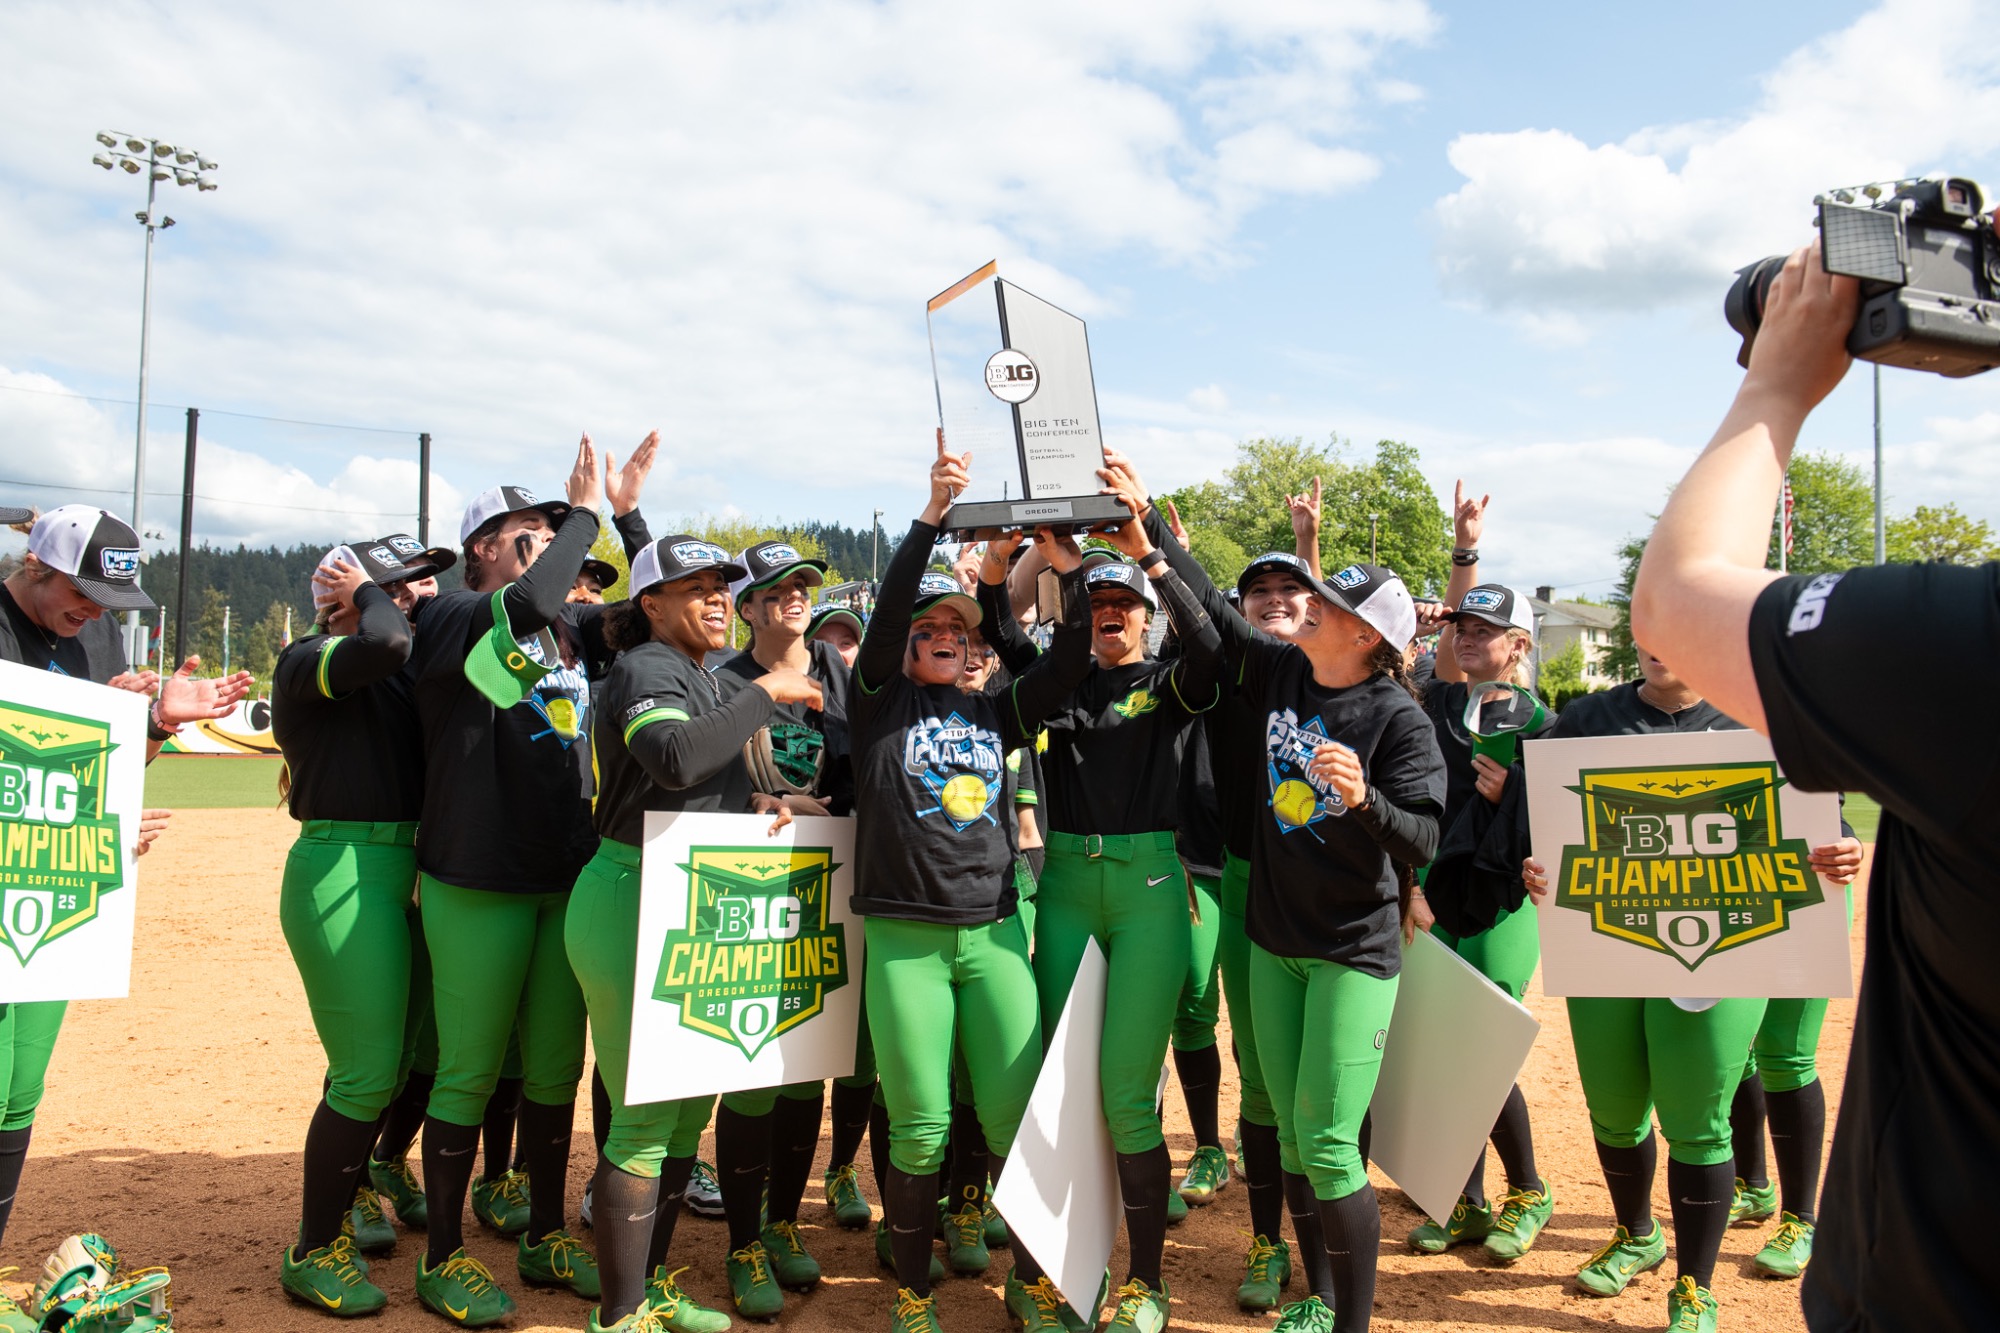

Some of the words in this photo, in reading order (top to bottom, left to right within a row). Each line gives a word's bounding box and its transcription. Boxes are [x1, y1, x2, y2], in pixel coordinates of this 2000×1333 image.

[1024, 420, 1047, 428] BIG
[1053, 418, 1079, 427] TEN
[1026, 429, 1090, 437] CONFERENCE
[1279, 762, 1291, 773] 20
[0, 821, 116, 874] MPIONS
[27, 874, 85, 887] SOFTBALL
[1568, 852, 1808, 895] CHAMPIONS
[58, 894, 77, 909] 25
[1611, 898, 1671, 907] OREGON
[1683, 897, 1763, 907] SOFTBALL
[1624, 913, 1648, 925] 20
[1728, 912, 1753, 924] 25
[664, 936, 840, 986] CHAMPIONS
[698, 986, 745, 997] OREGON
[753, 982, 810, 993] SOFTBALL
[706, 1003, 726, 1016] 20
[784, 997, 801, 1010] 25
